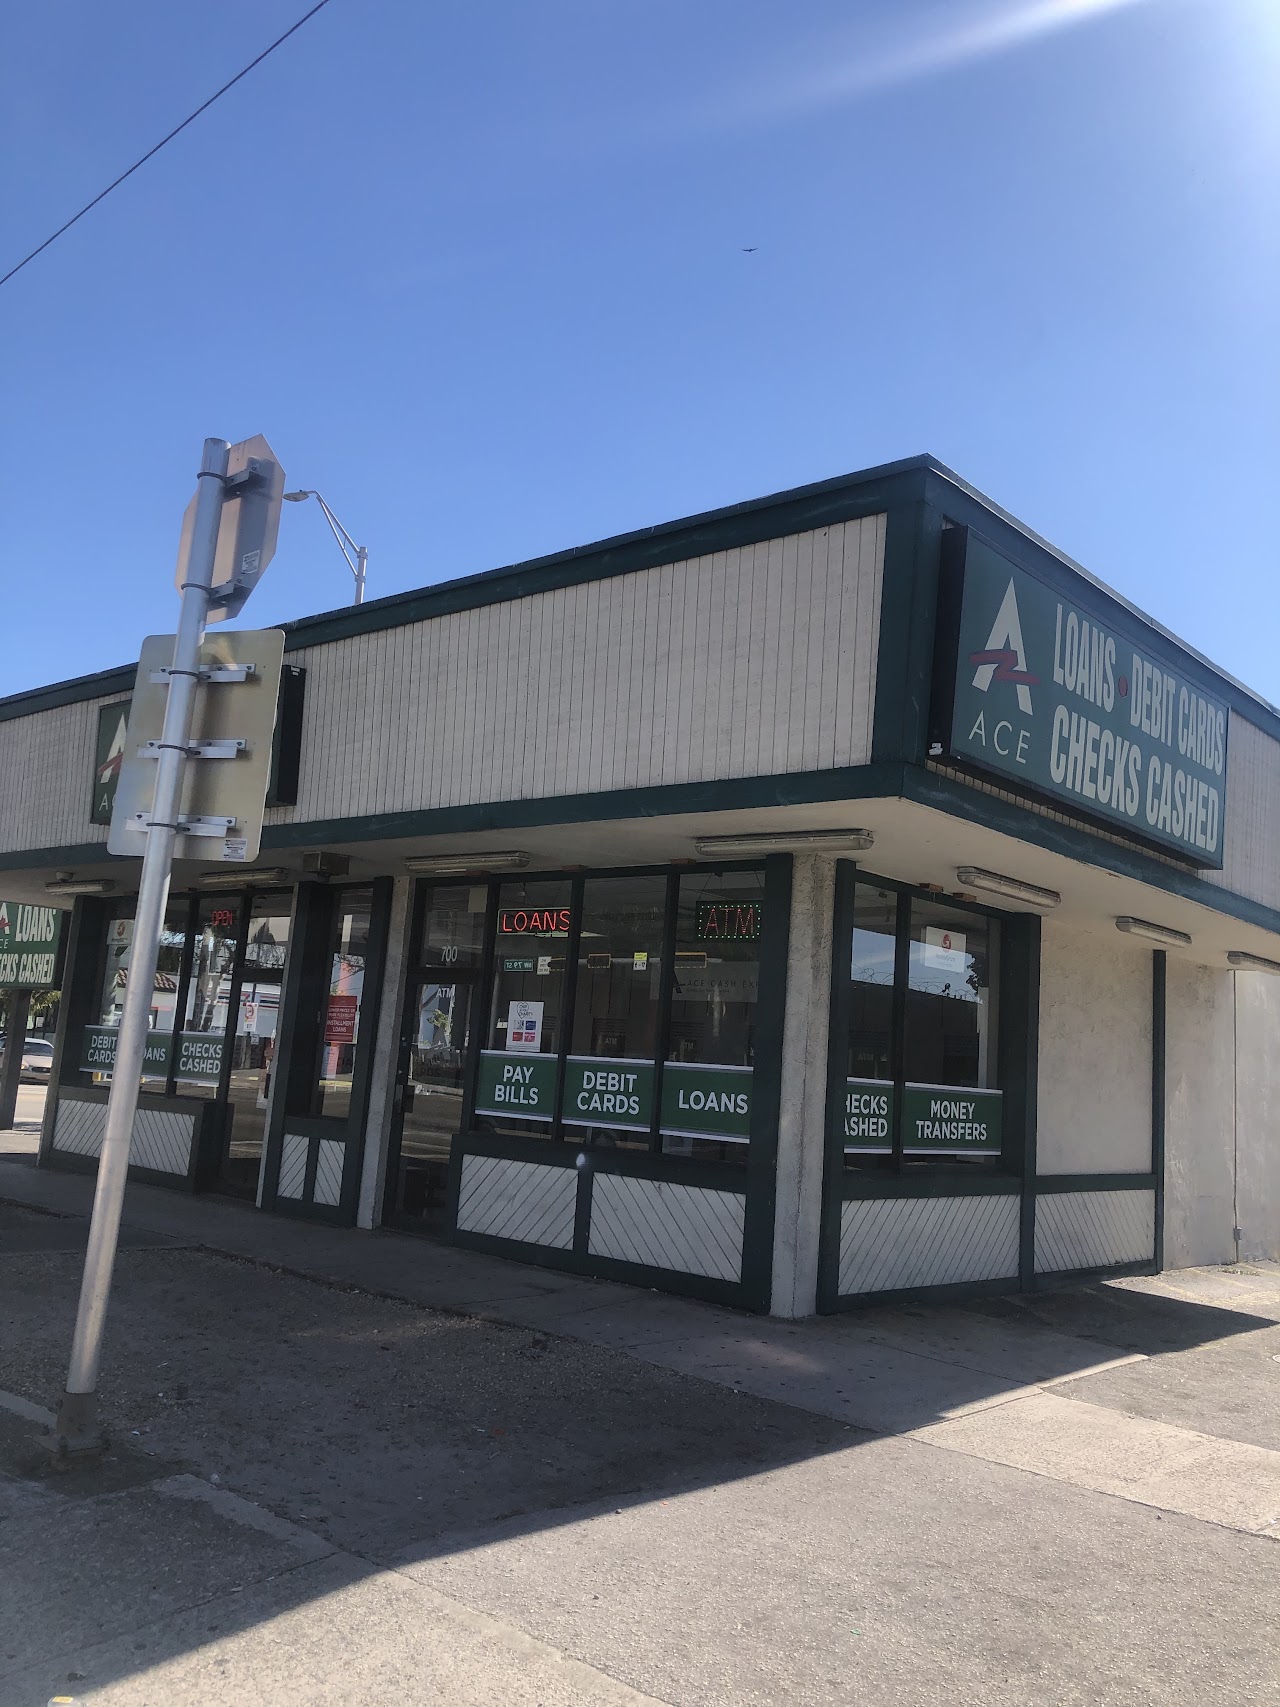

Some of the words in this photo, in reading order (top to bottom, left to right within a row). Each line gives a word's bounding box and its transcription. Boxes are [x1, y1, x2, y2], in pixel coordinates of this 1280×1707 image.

[1053, 603, 1116, 713] LOANS
[1130, 653, 1177, 747] DEBIT
[1177, 686, 1225, 776] CARDS
[968, 710, 1031, 765] ACE
[1050, 704, 1142, 817] CHECKS
[1145, 755, 1219, 853] CASHED
[15, 904, 56, 942] LOANS
[212, 910, 233, 926] OPEN
[502, 910, 571, 932] LOANS
[704, 908, 754, 936] ATM
[441, 946, 458, 963] 700
[18, 953, 55, 984] CASHED
[91, 1035, 118, 1049] DEBIT
[181, 1042, 223, 1059] CHECKS
[87, 1049, 117, 1063] CARDS
[179, 1057, 221, 1074] CASHED
[503, 1065, 534, 1084] PAY
[583, 1070, 638, 1093] DEBIT
[494, 1084, 539, 1106] BILLS
[576, 1091, 640, 1116] CARDS
[678, 1089, 749, 1115] LOANS
[845, 1093, 888, 1116] HECKS
[930, 1099, 976, 1120] MONEY
[915, 1120, 987, 1141] TRANSFERS
